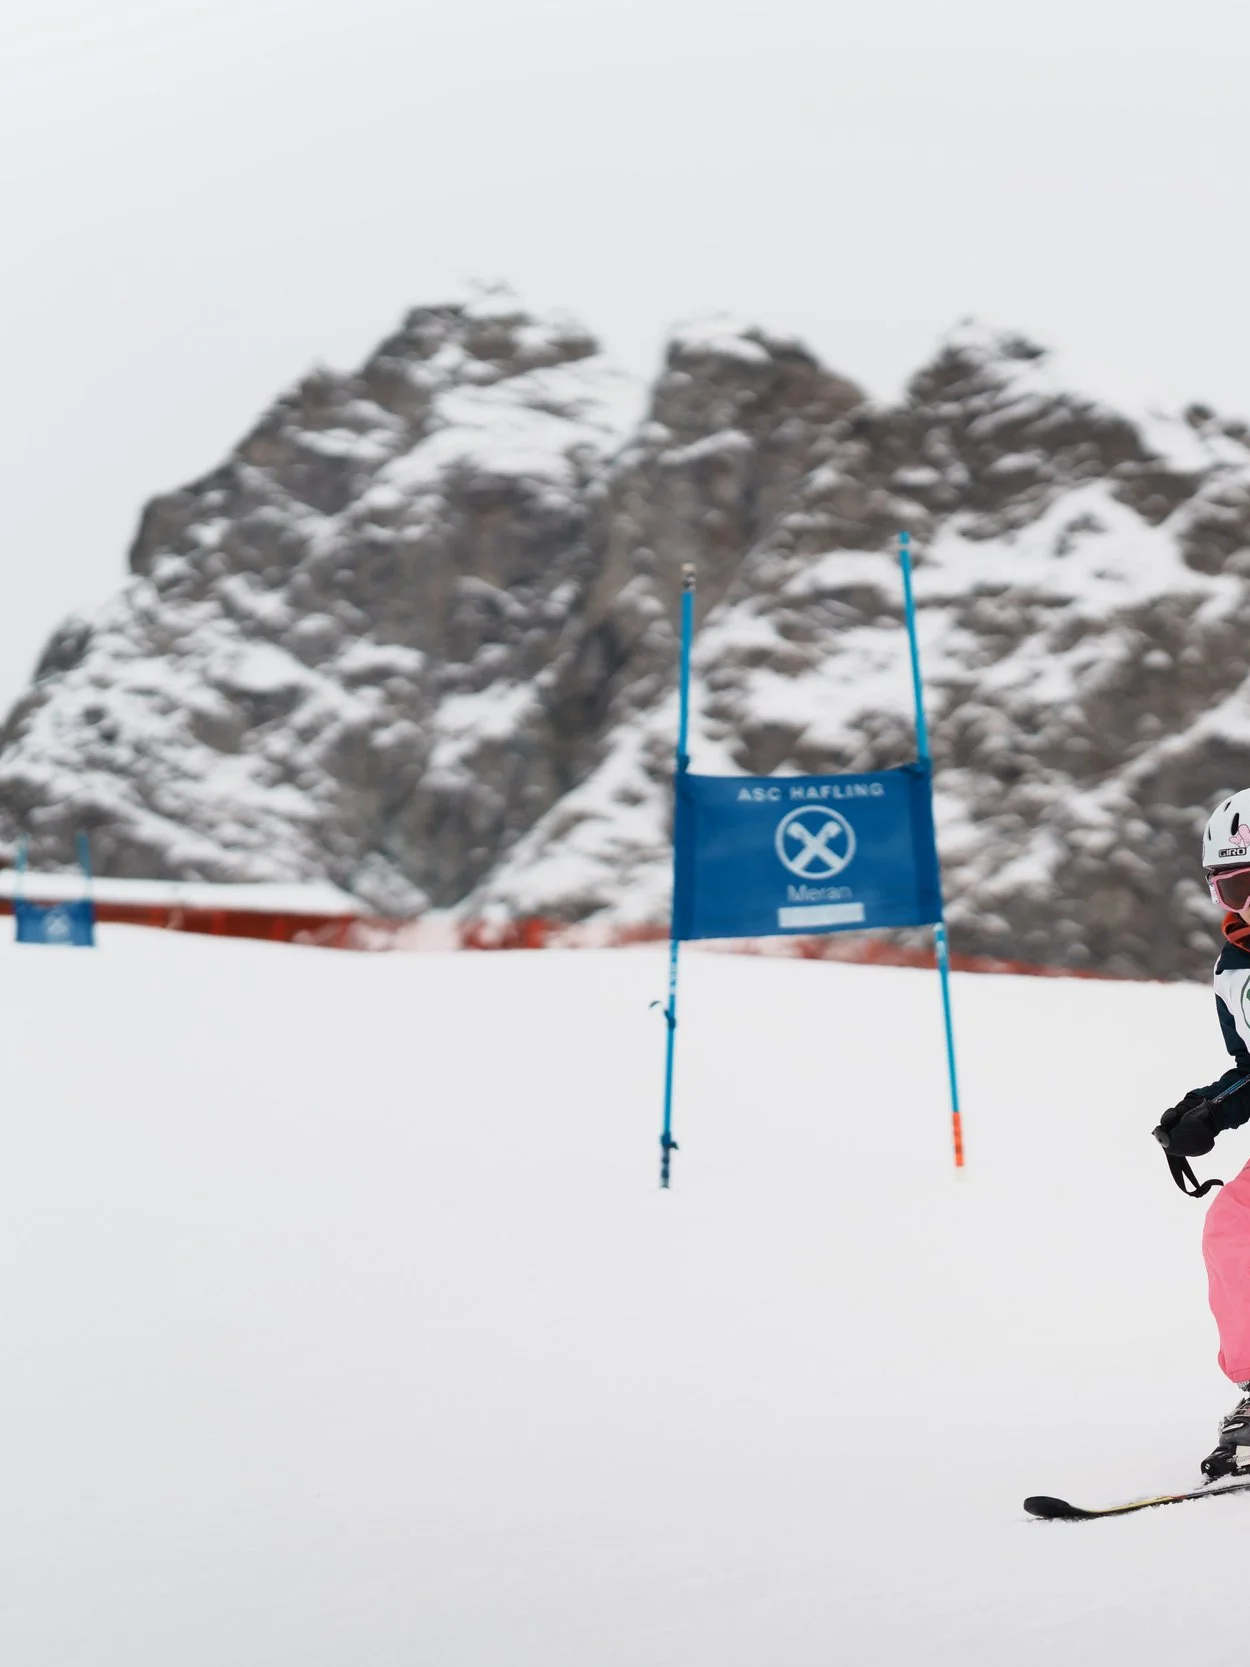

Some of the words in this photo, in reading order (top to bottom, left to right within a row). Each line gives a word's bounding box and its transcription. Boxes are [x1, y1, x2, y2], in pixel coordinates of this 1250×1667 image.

[738, 787, 781, 801] ASC
[790, 783, 885, 800] HAFLING
[1219, 847, 1246, 857] GIRO
[787, 885, 852, 901] Meran
